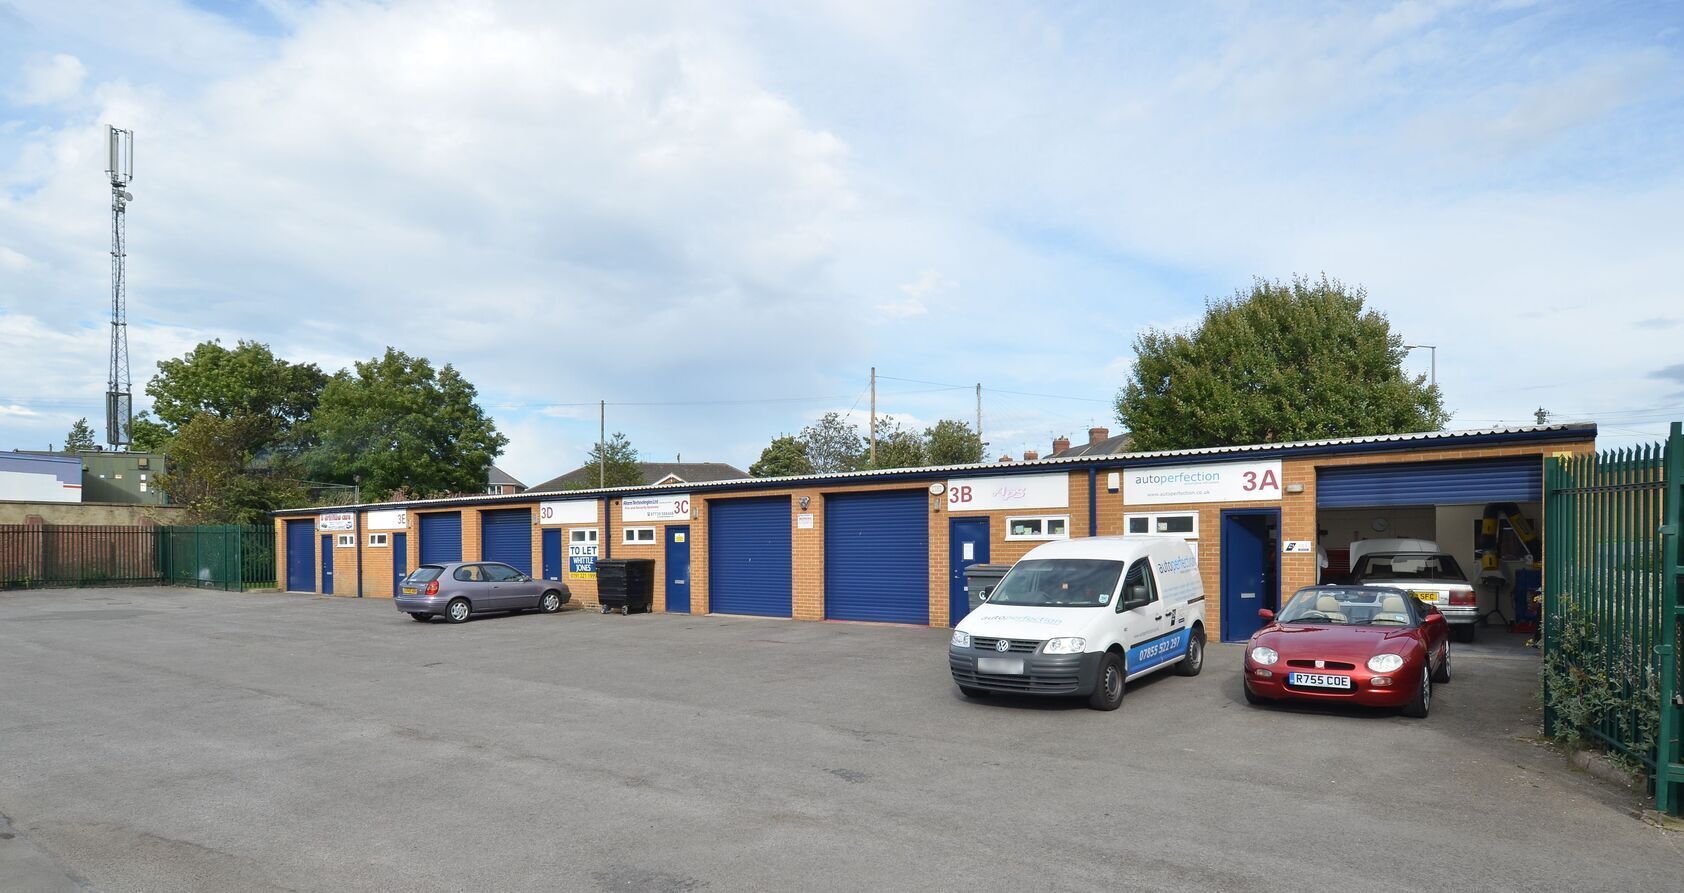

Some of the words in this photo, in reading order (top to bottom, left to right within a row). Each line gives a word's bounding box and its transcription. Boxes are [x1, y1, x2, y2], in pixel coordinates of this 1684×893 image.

[1135, 472, 1220, 485] autoperfection
[1242, 469, 1280, 492] 3A
[949, 485, 973, 504] 3B
[541, 506, 553, 518] 3D
[674, 500, 689, 514] 3C
[397, 513, 406, 525] 3E
[570, 546, 581, 555] TO
[582, 546, 597, 555] LET
[573, 556, 594, 564] WHITTLE
[576, 564, 592, 572] JONES
[1139, 644, 1159, 661] 07855
[1158, 640, 1170, 654] 522
[1169, 636, 1181, 649] 297
[1296, 674, 1324, 684] R755
[1326, 676, 1348, 686] COE
